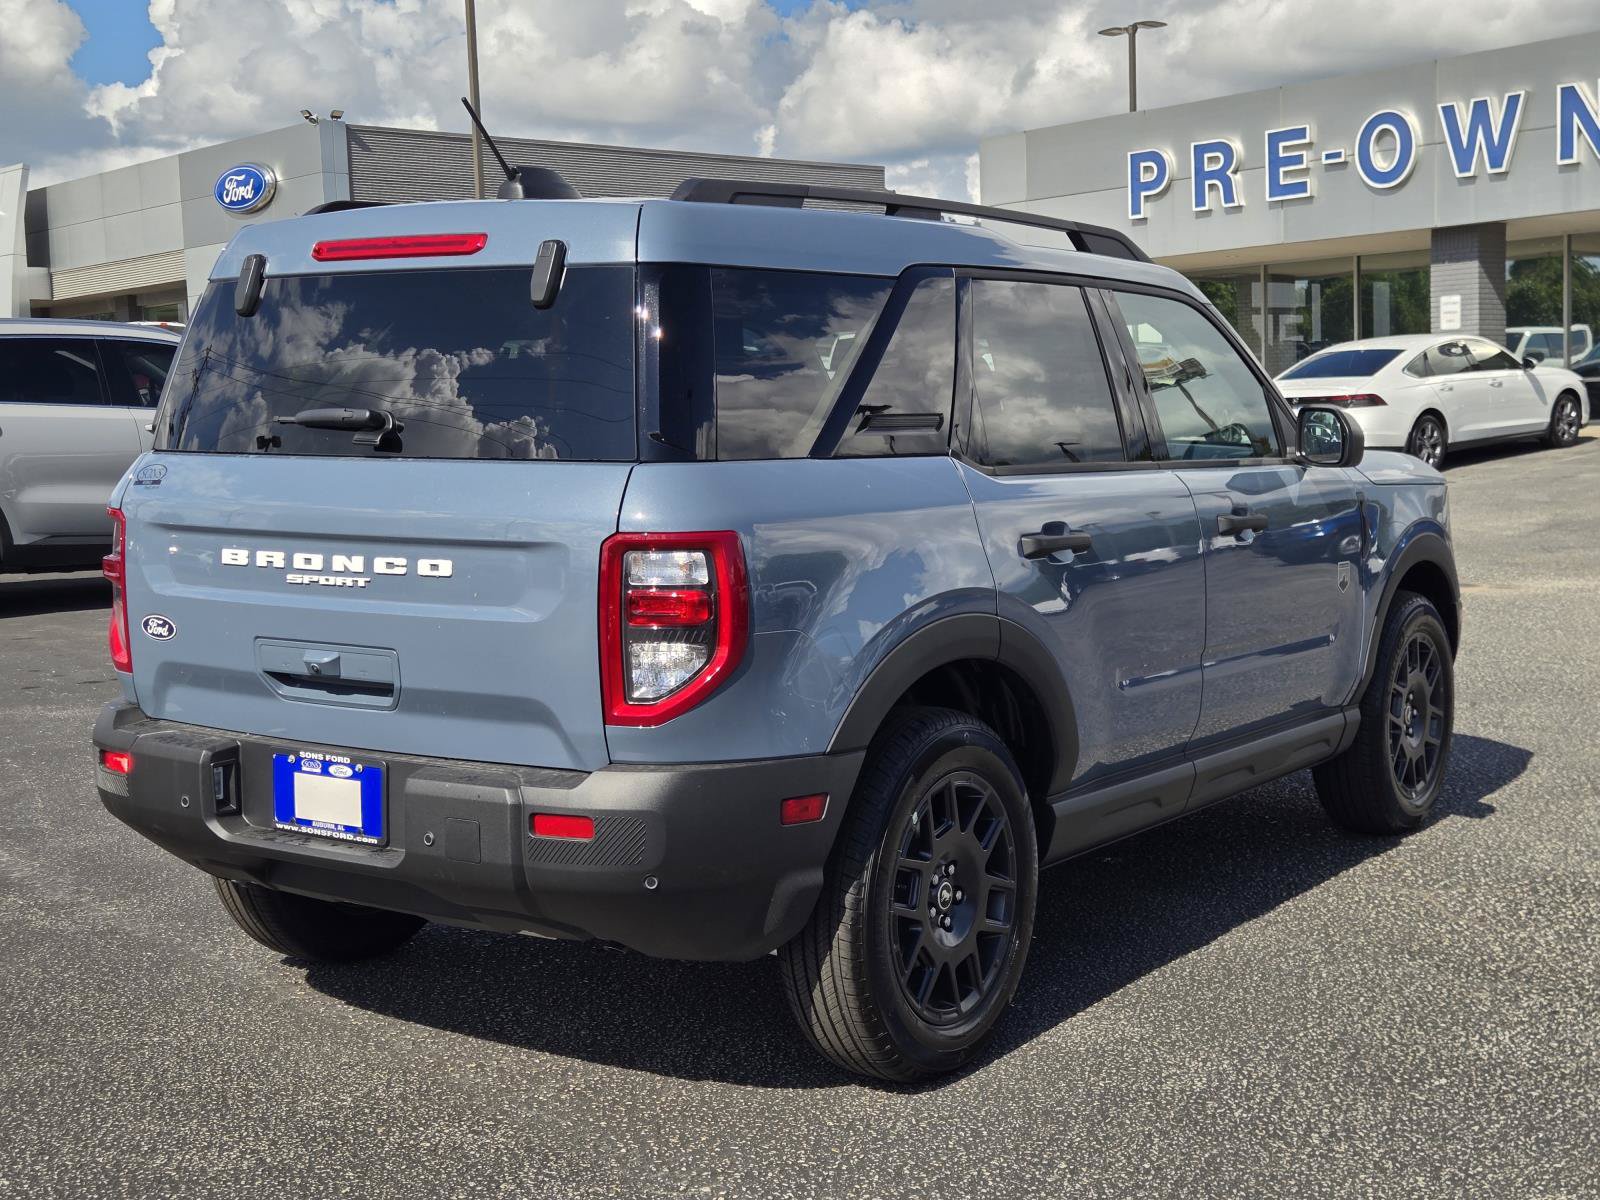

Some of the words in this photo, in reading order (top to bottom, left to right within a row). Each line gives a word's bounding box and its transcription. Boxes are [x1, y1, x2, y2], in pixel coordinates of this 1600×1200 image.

[223, 174, 255, 204] Ford
[221, 547, 453, 577] BRONCO
[286, 573, 371, 588] SPORT
[147, 618, 169, 637] Ford
[300, 752, 323, 760] SONS
[326, 755, 350, 763] FORD
[276, 823, 378, 843] www.SONSFORD.com
